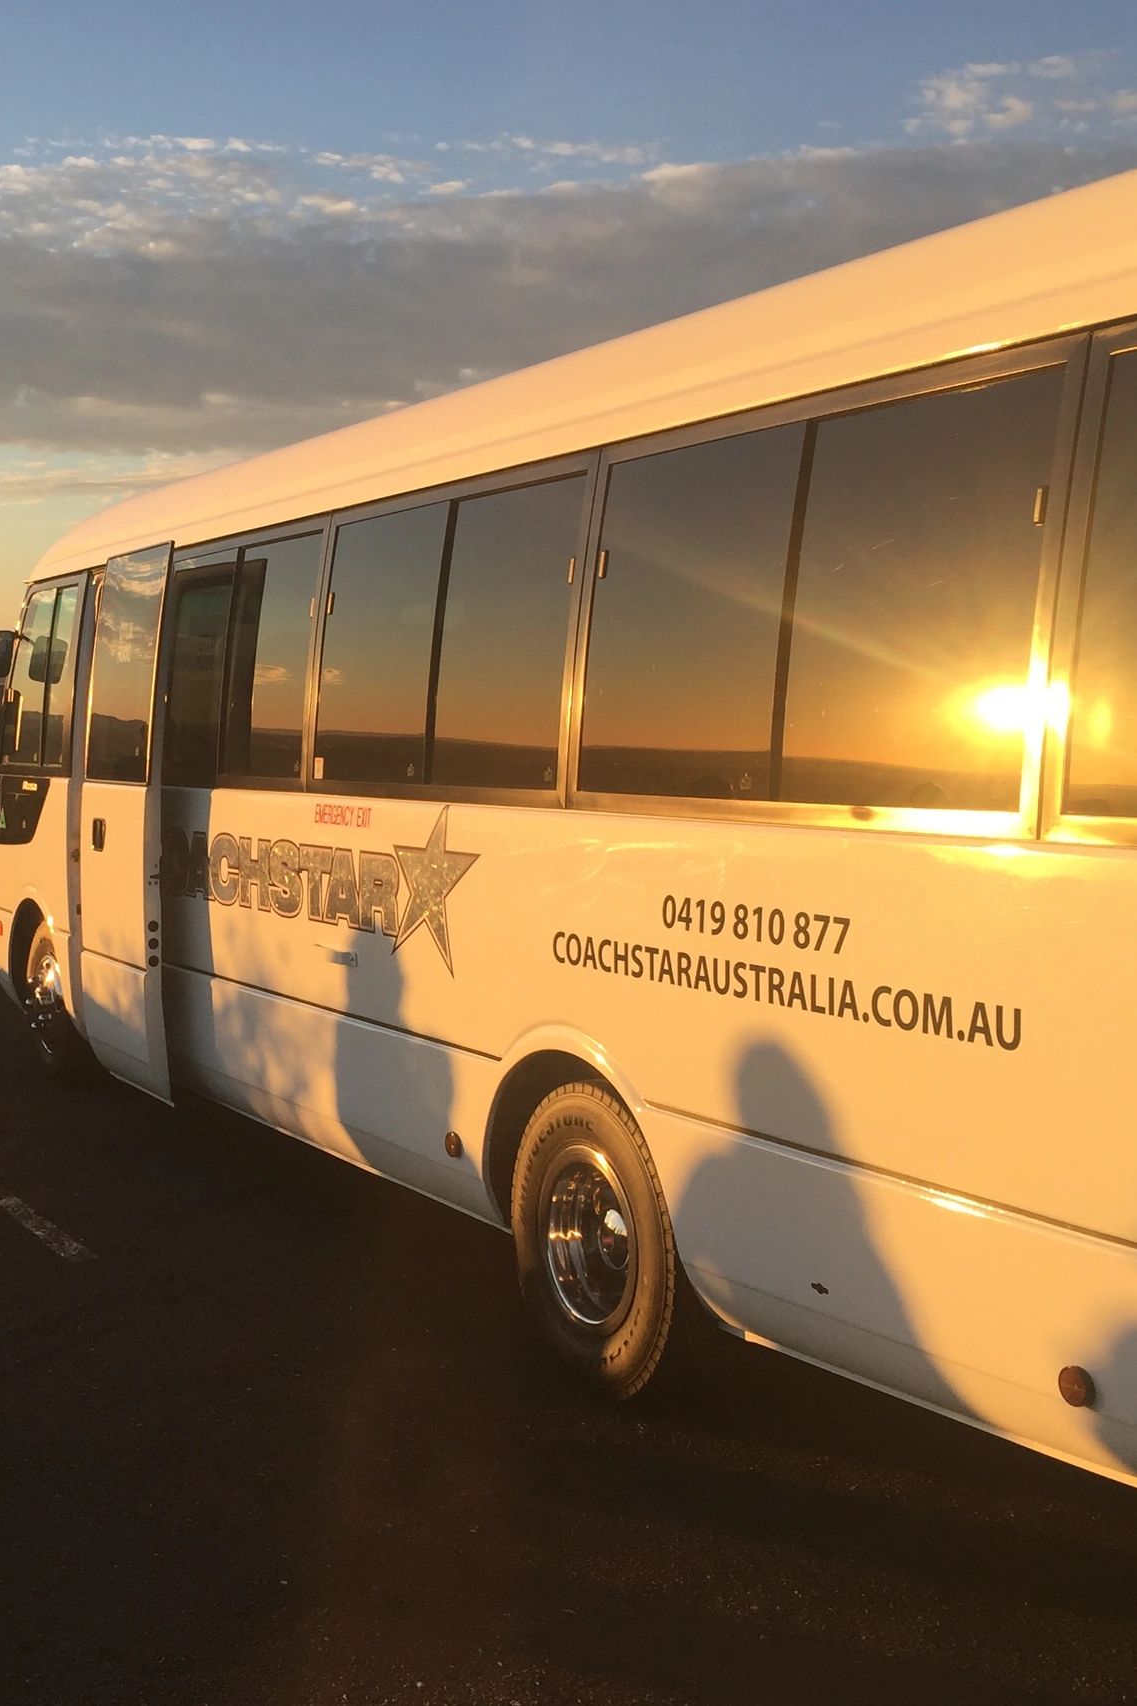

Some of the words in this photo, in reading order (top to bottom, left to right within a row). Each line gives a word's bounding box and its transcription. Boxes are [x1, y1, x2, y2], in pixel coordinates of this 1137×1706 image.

[314, 803, 354, 827] EMERGENCY
[356, 807, 372, 828] EXIT
[662, 894, 726, 936] 0419
[732, 903, 785, 946] 810
[792, 911, 851, 955] 877
[552, 931, 1022, 1051] COACHSTARAUSTRALIA.COM.AU
